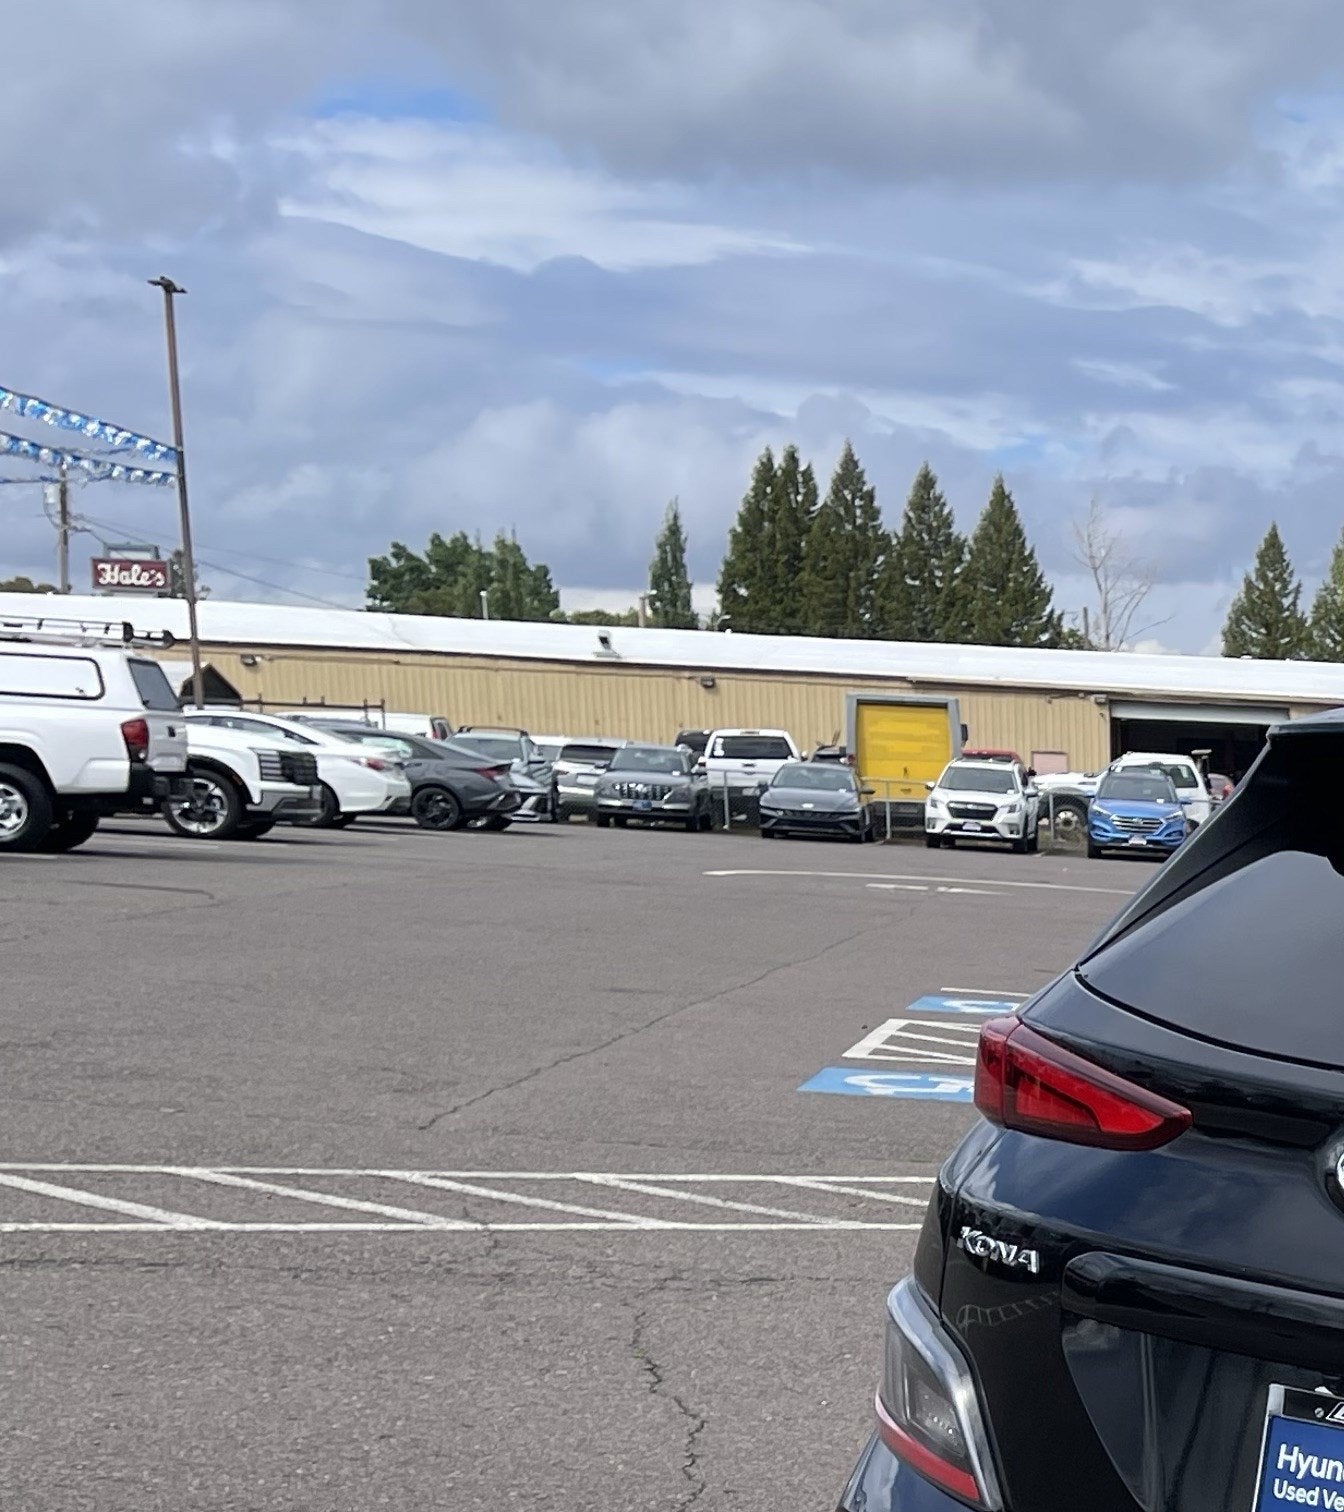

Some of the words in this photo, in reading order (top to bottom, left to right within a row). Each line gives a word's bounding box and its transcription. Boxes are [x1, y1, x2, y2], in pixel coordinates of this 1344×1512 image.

[97, 562, 166, 587] Hale's
[957, 1225, 1040, 1274] KONA
[1273, 1478, 1320, 1507] Used
